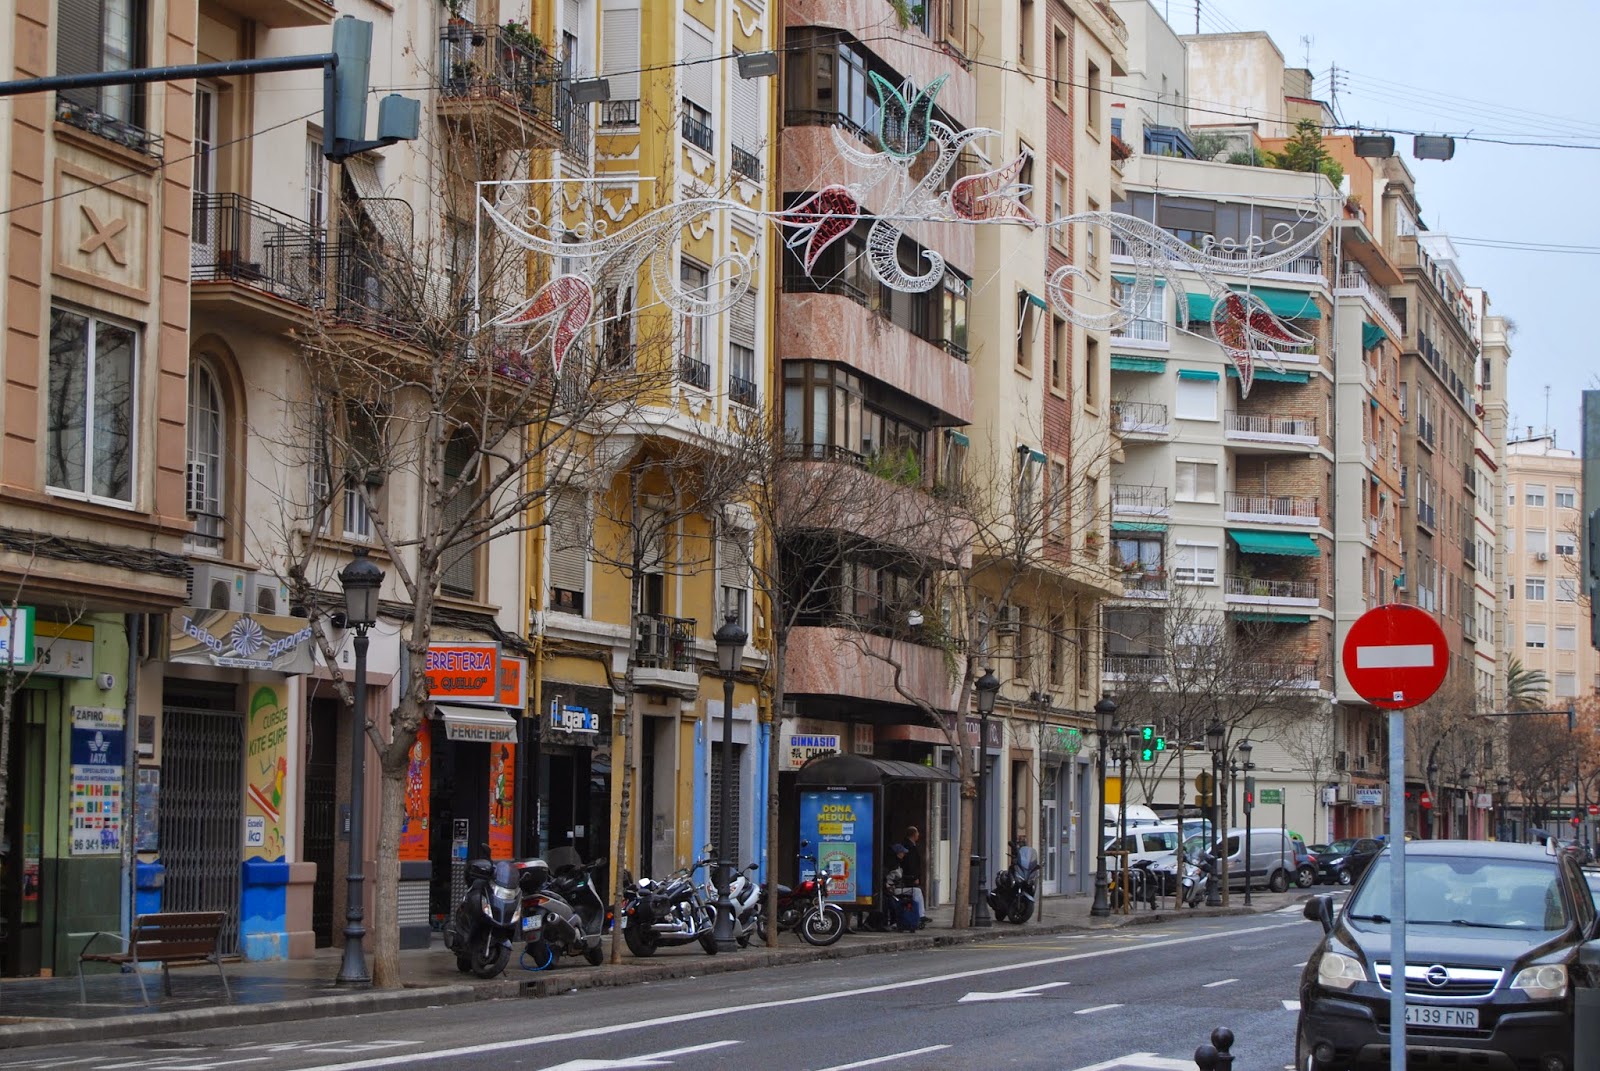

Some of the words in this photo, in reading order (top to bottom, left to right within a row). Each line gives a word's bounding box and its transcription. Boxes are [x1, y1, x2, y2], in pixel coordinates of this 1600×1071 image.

[182, 616, 222, 651] Tadeo
[268, 627, 312, 656] sports
[425, 650, 492, 671] ERRETERIA
[76, 710, 103, 721] ZAFIRO
[262, 706, 288, 730] CURSOS
[267, 724, 288, 749] SURF
[451, 724, 511, 740] FERRETERIA
[90, 753, 107, 764] IATA
[823, 805, 852, 813] DONA
[74, 839, 83, 850] 96
[1445, 1010, 1475, 1025] FNR
